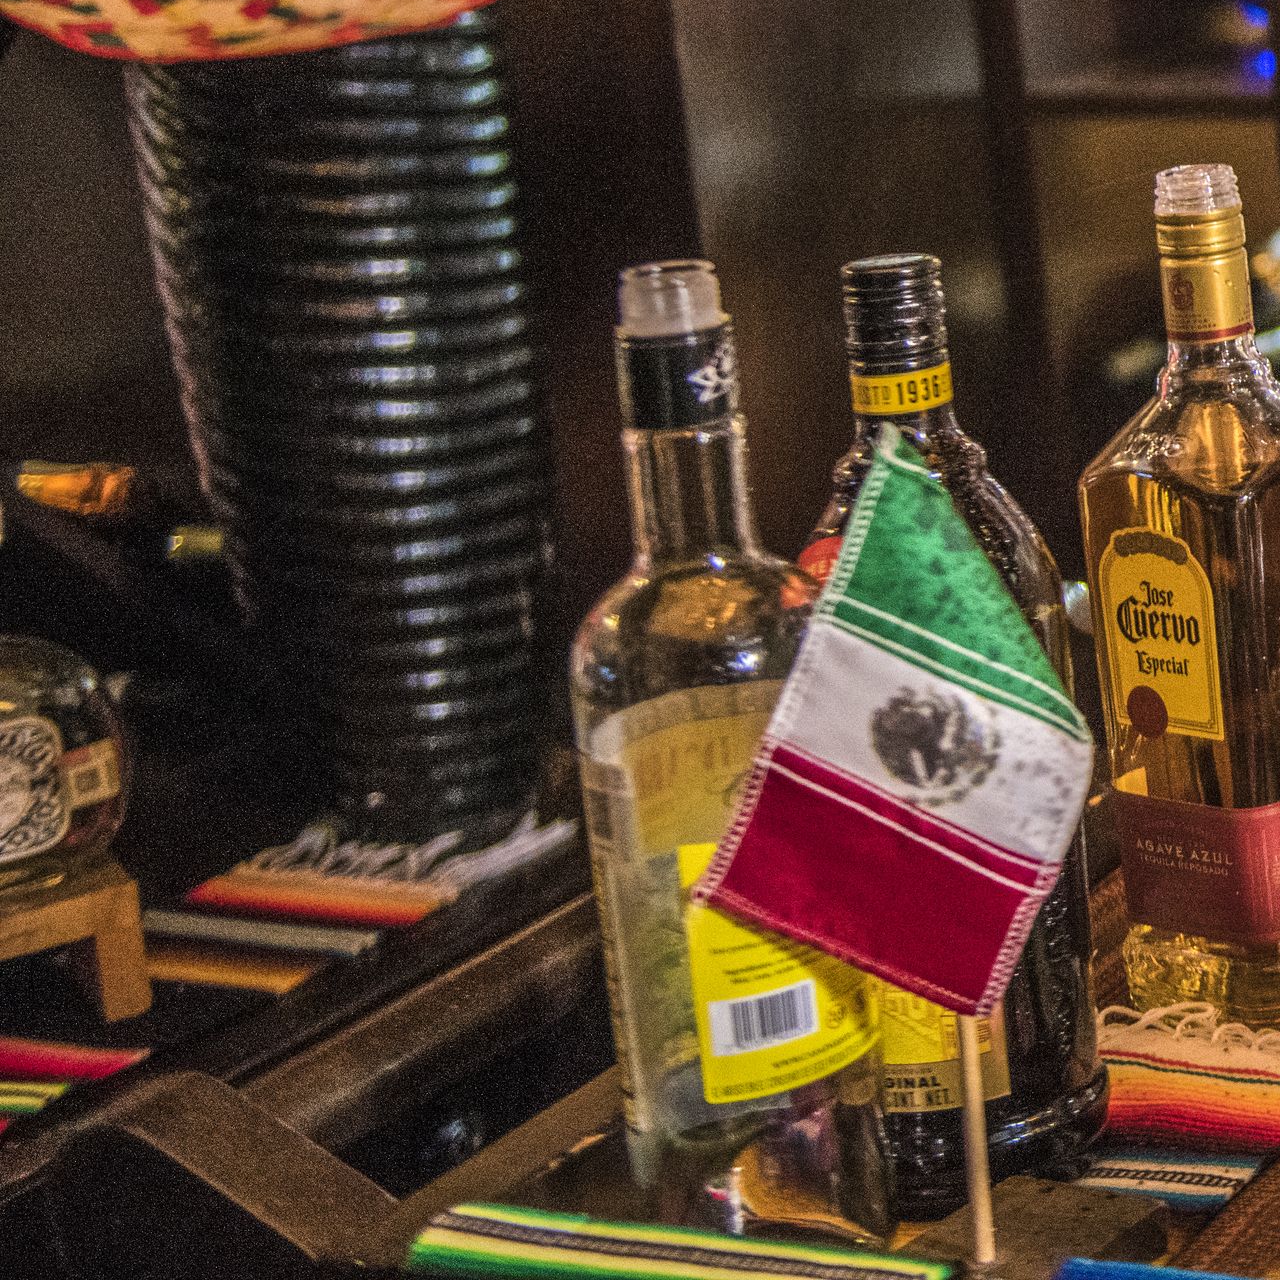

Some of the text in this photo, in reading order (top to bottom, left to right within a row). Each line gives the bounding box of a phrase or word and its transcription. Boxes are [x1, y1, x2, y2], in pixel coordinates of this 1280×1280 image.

[896, 374, 940, 406] 1936
[1139, 580, 1173, 608] Jose
[1117, 595, 1201, 646] Cuervo
[1136, 650, 1189, 676] Especial
[1136, 838, 1233, 866] AGAVE AZUL
[885, 1075, 941, 1089] GINAL
